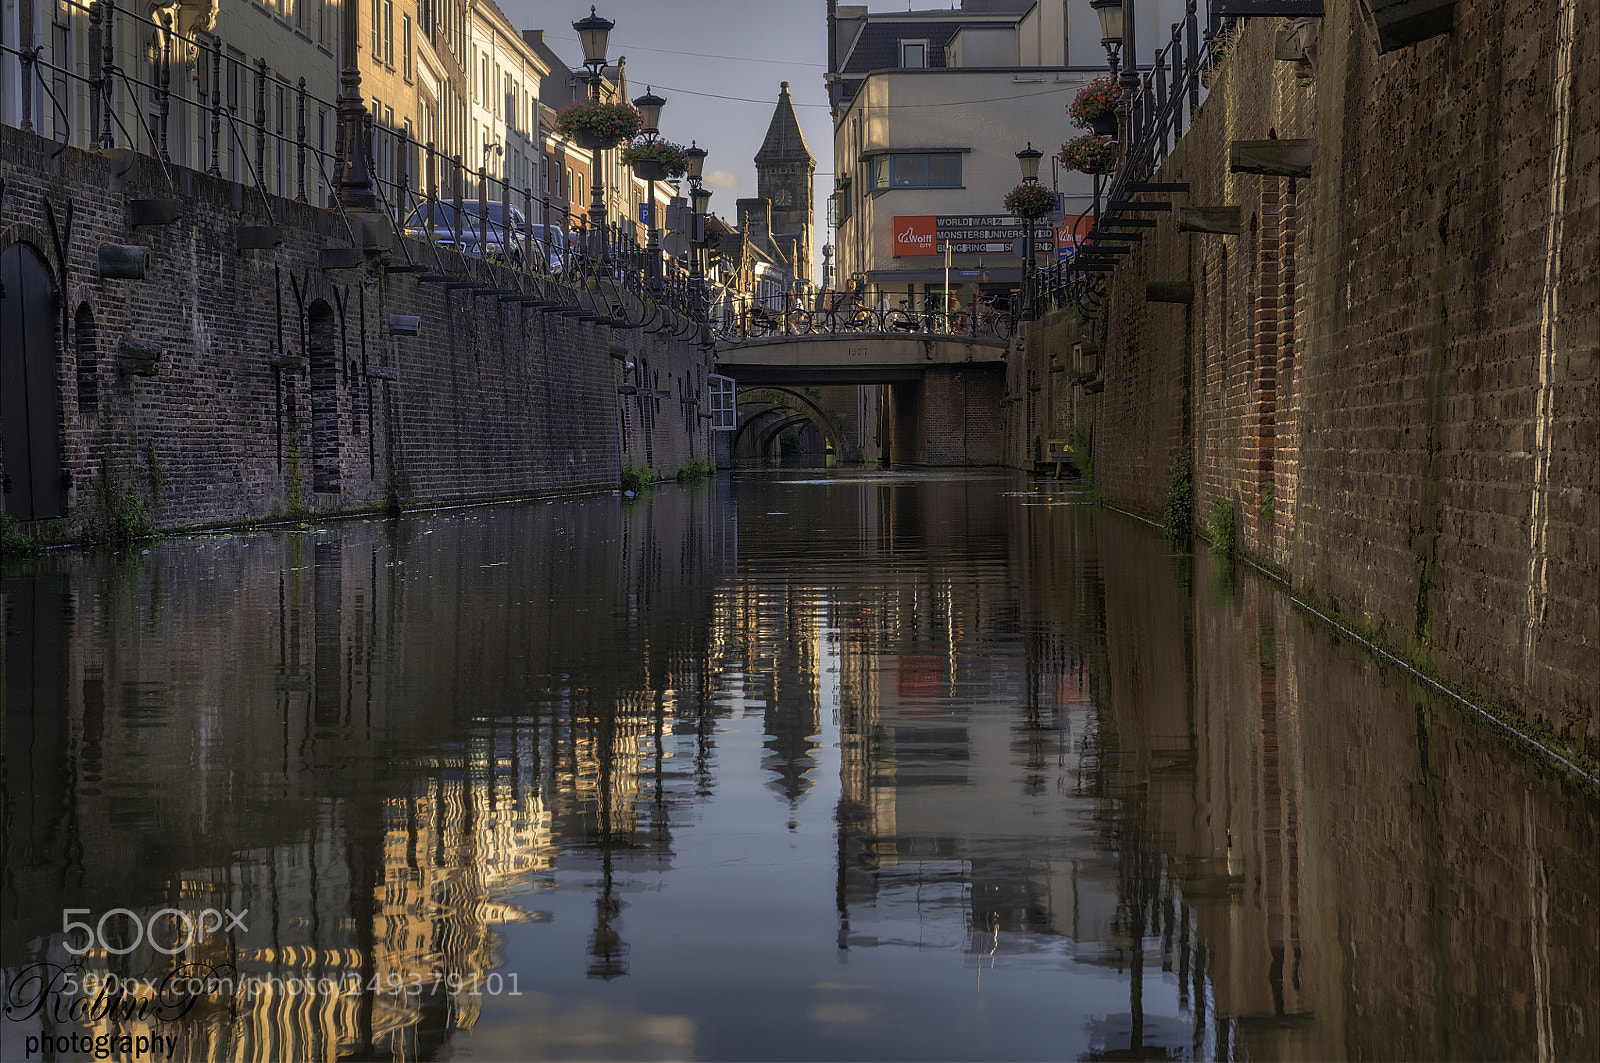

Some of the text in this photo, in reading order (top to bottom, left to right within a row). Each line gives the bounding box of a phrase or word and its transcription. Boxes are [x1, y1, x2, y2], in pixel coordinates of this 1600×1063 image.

[642, 209, 649, 220] P
[936, 218, 969, 226] WORLD
[972, 217, 993, 226] WAR
[995, 217, 1002, 225] Z
[909, 234, 932, 243] Wolff
[936, 231, 985, 239] MONSTERS
[1041, 230, 1053, 239] 3D
[966, 243, 986, 252] RING
[1047, 243, 1053, 251] 2
[848, 347, 868, 356] 1907
